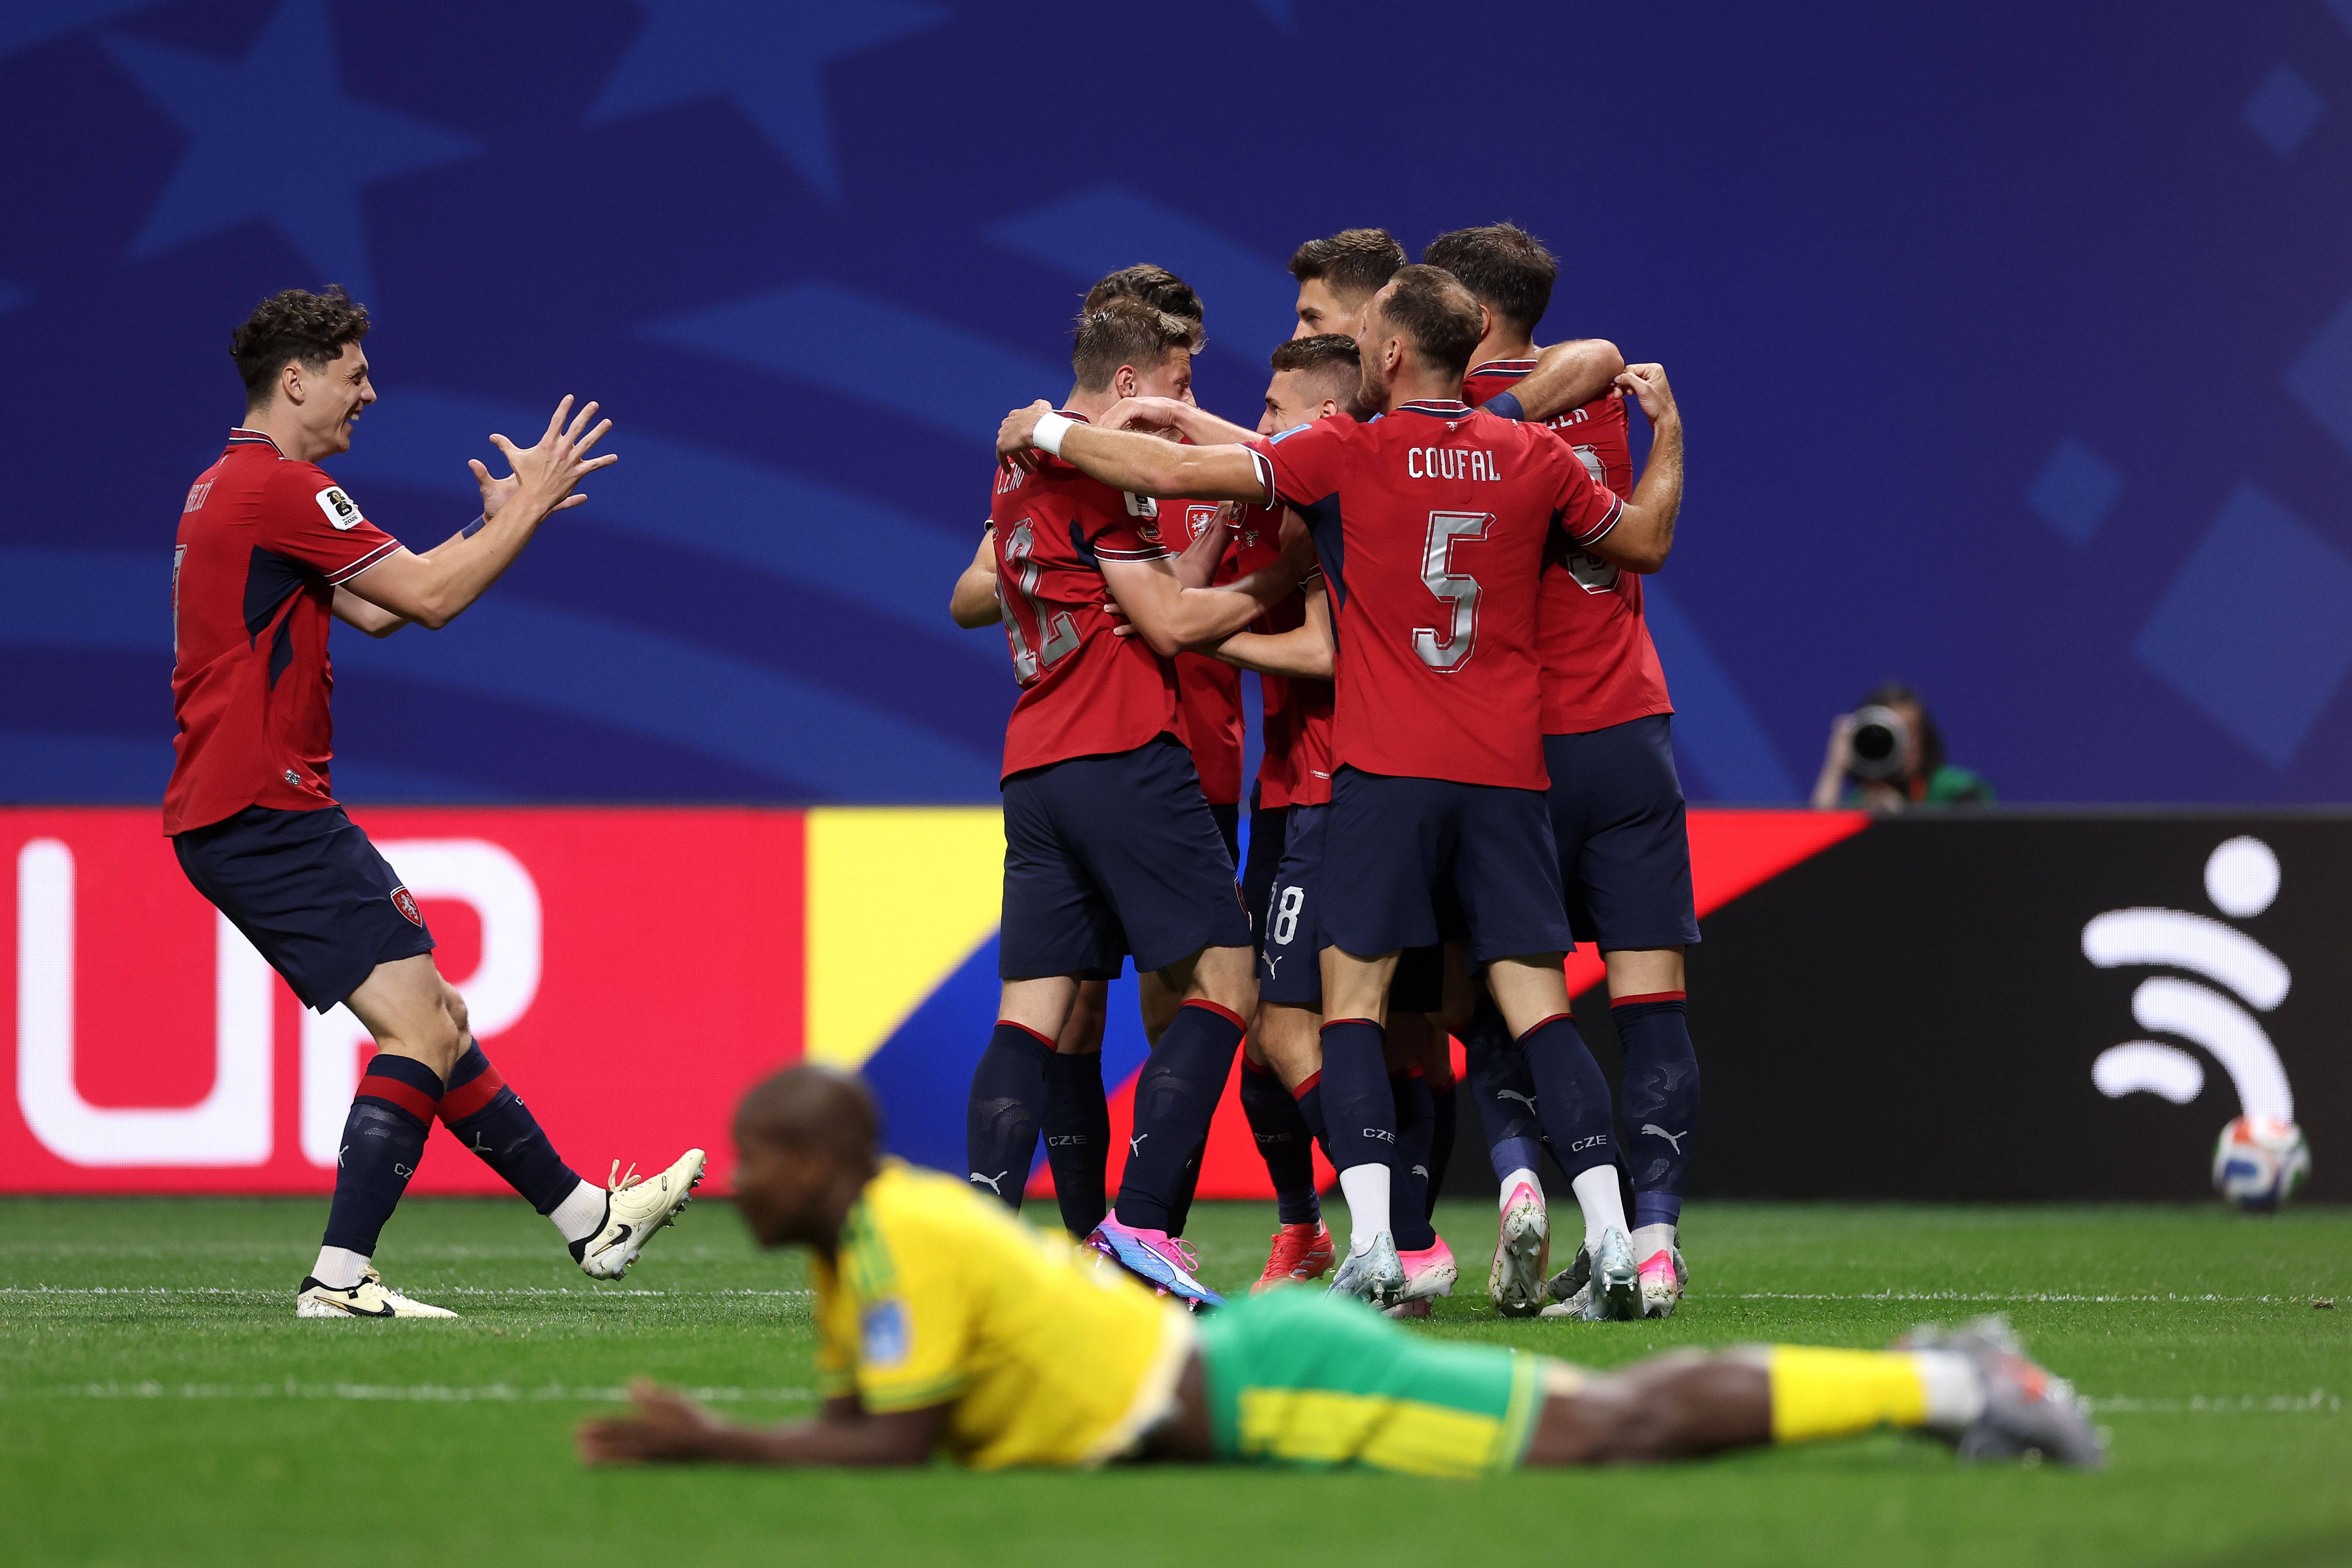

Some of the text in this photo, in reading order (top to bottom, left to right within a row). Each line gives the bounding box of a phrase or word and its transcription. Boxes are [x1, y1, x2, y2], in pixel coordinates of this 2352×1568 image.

[1409, 447, 1501, 481] COUFAL
[344, 516, 358, 525] 2026
[1411, 510, 1497, 673] 5
[1264, 881, 1304, 946] 18
[17, 838, 542, 1167] UP
[1049, 1135, 1087, 1146] CZE
[1254, 1132, 1292, 1143] CZE
[1363, 1128, 1395, 1144] CZE
[1571, 1135, 1607, 1152] CZE
[1386, 1237, 1395, 1262] ULTRA
